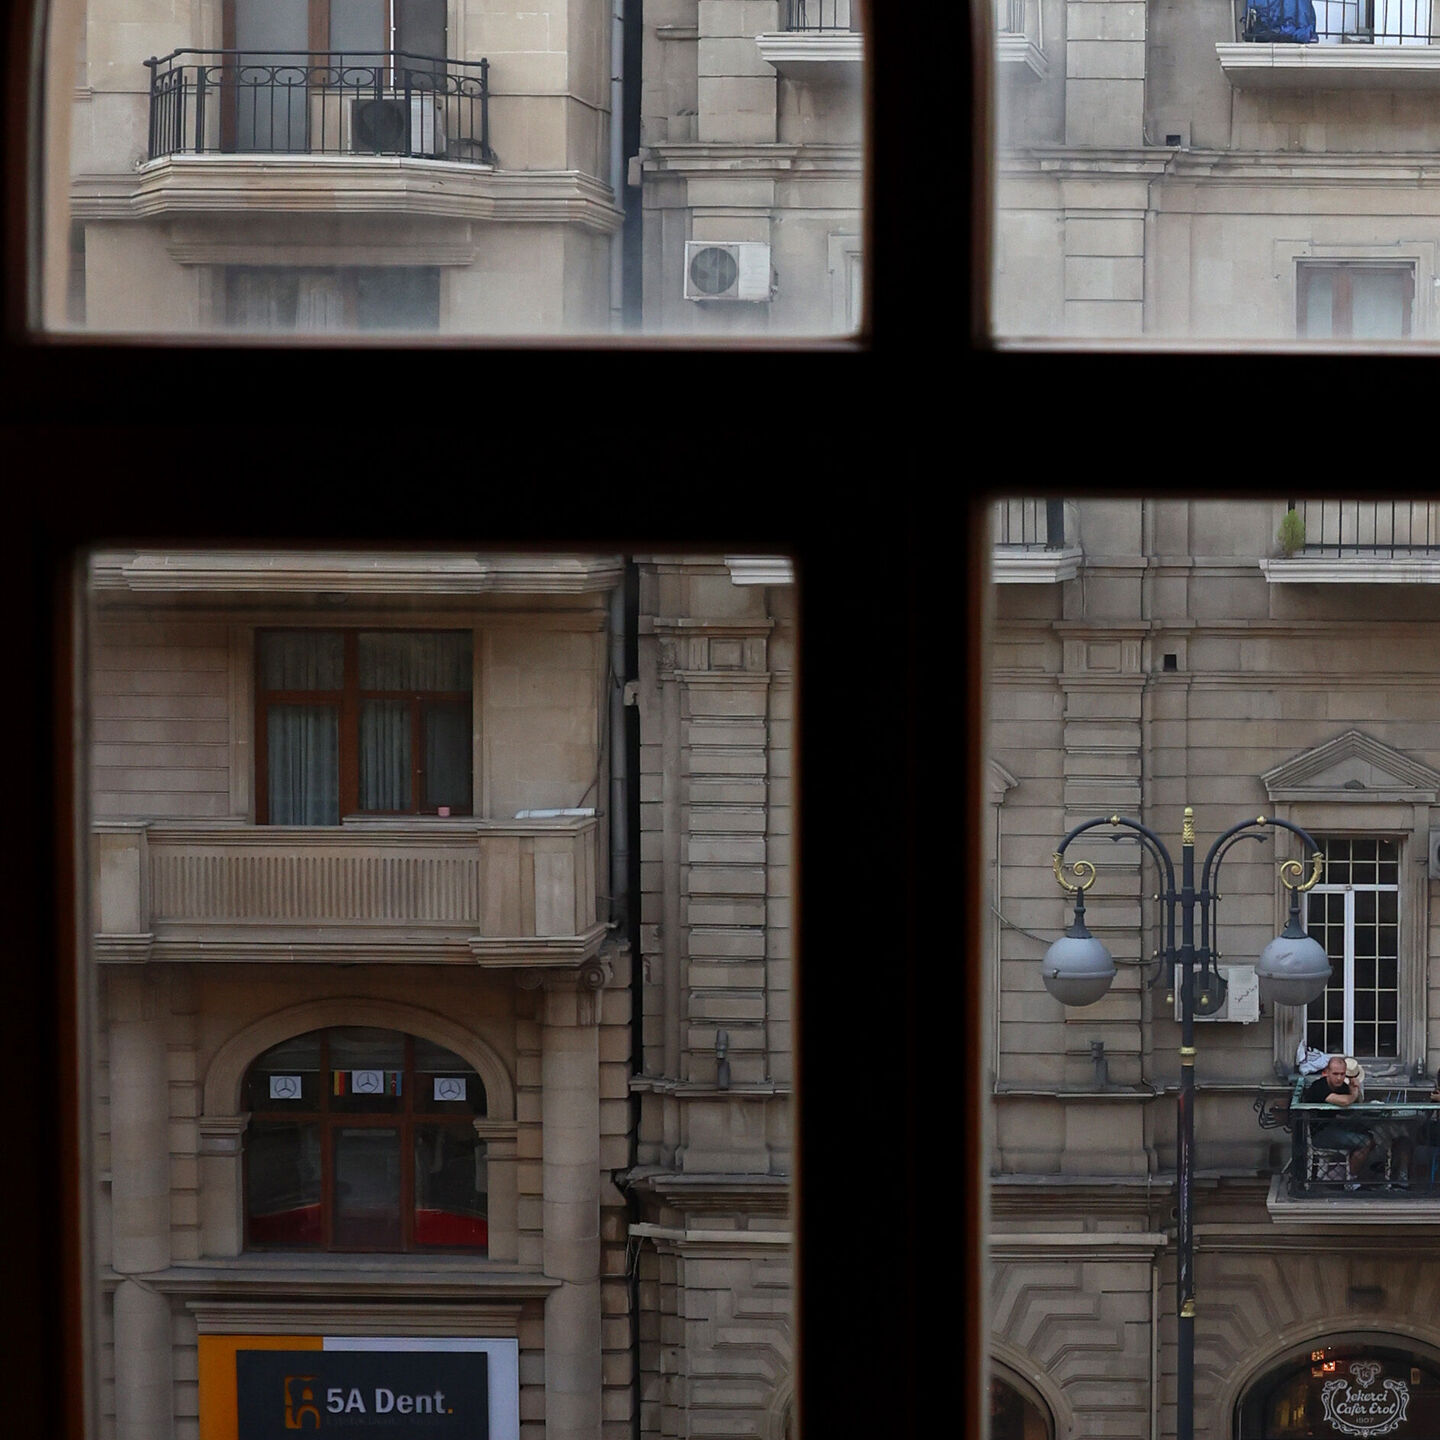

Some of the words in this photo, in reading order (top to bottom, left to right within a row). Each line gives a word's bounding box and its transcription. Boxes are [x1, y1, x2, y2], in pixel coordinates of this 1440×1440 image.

[326, 1388, 367, 1415] 5A
[375, 1388, 454, 1415] Dent.
[1336, 1402, 1368, 1416] Cafer
[1369, 1402, 1396, 1415] Erol
